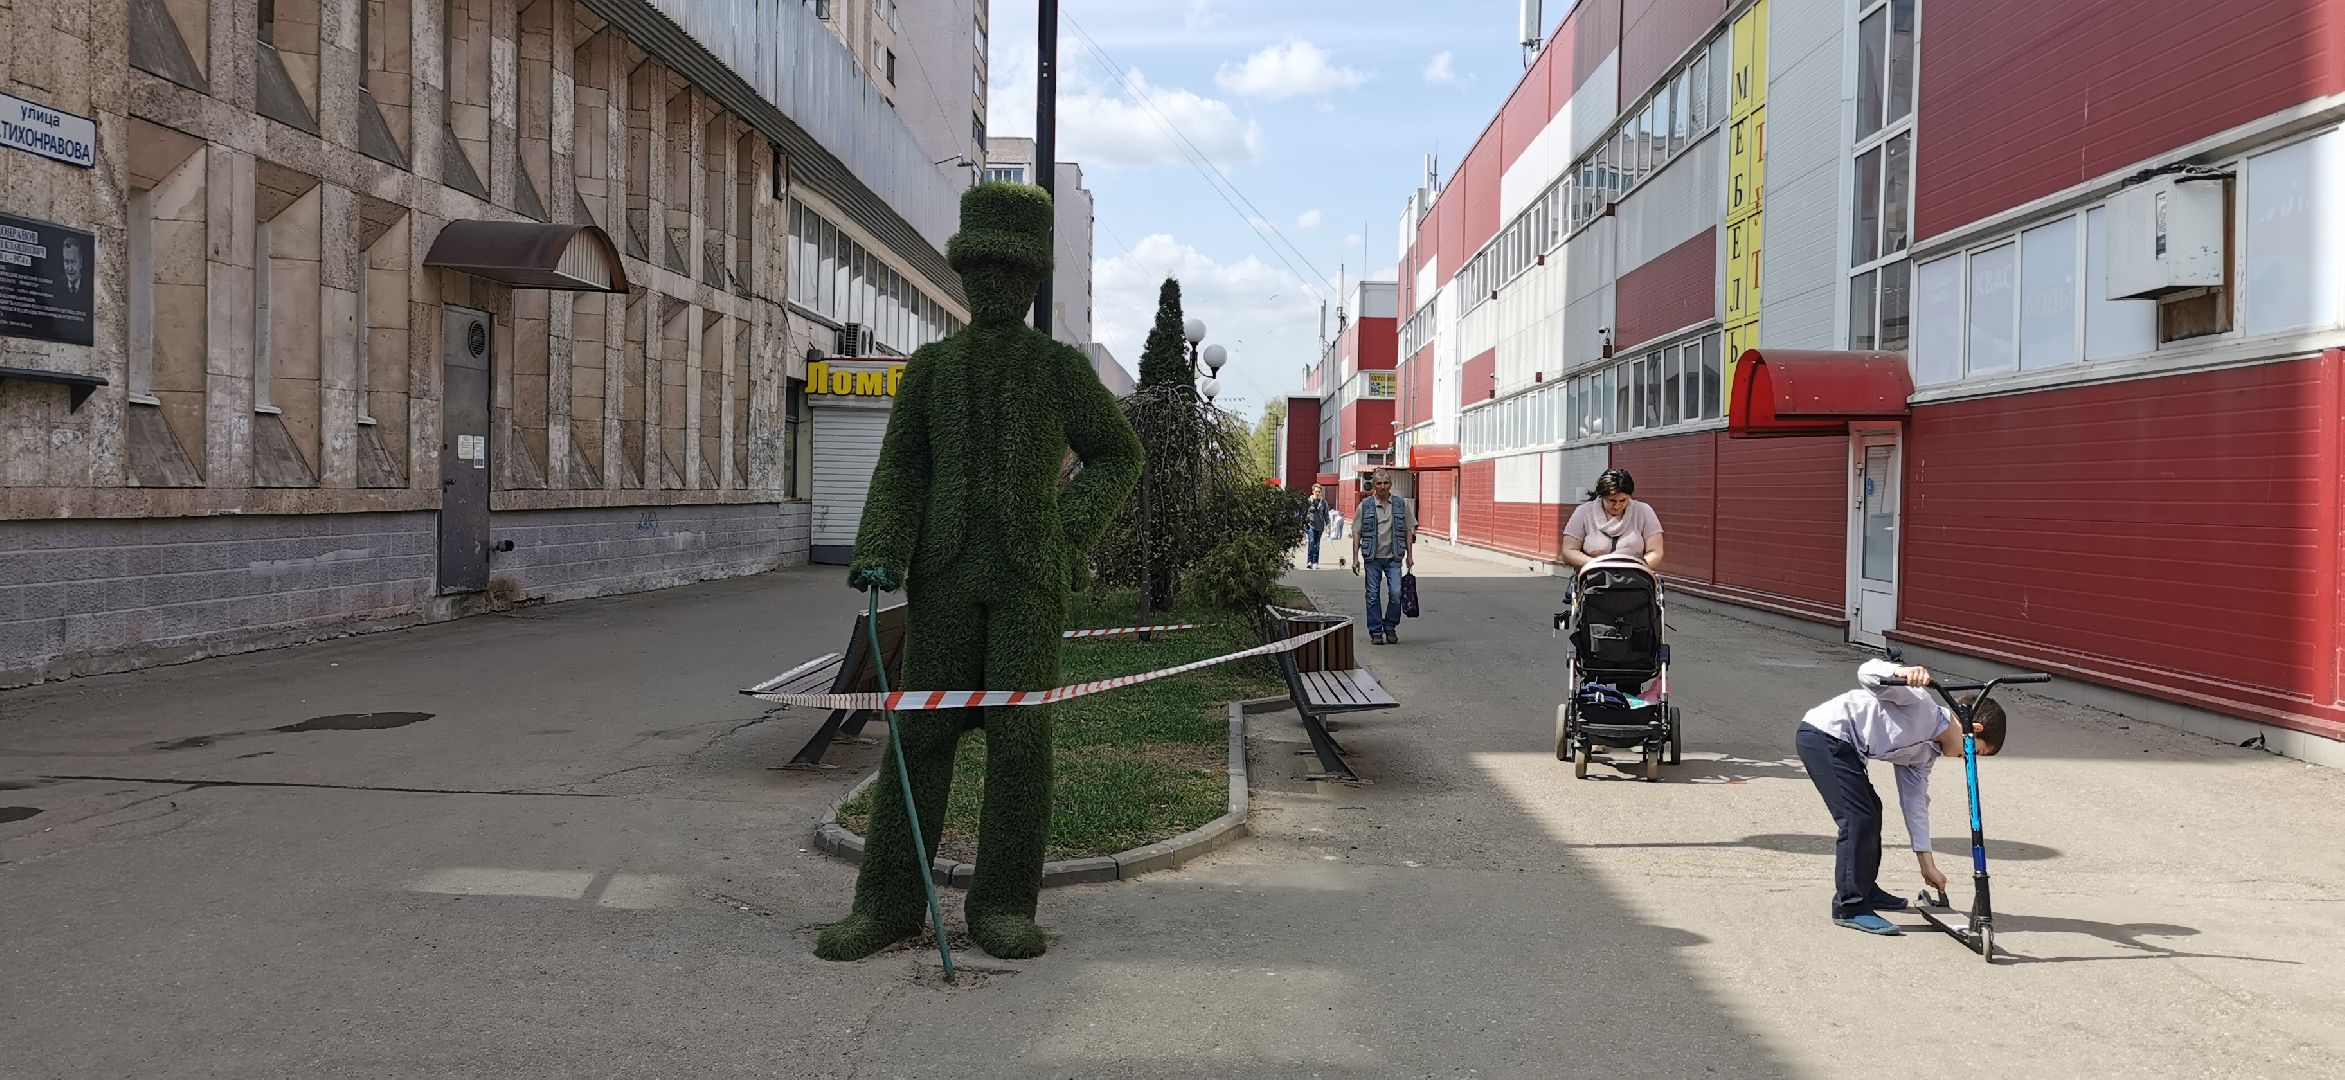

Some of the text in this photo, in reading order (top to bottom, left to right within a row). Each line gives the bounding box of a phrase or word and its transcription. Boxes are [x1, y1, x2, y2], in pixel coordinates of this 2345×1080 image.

[20, 105, 60, 127] улица
[1729, 64, 1750, 364] МЕБЕЛЬ
[1752, 121, 1766, 290] ТУТ
